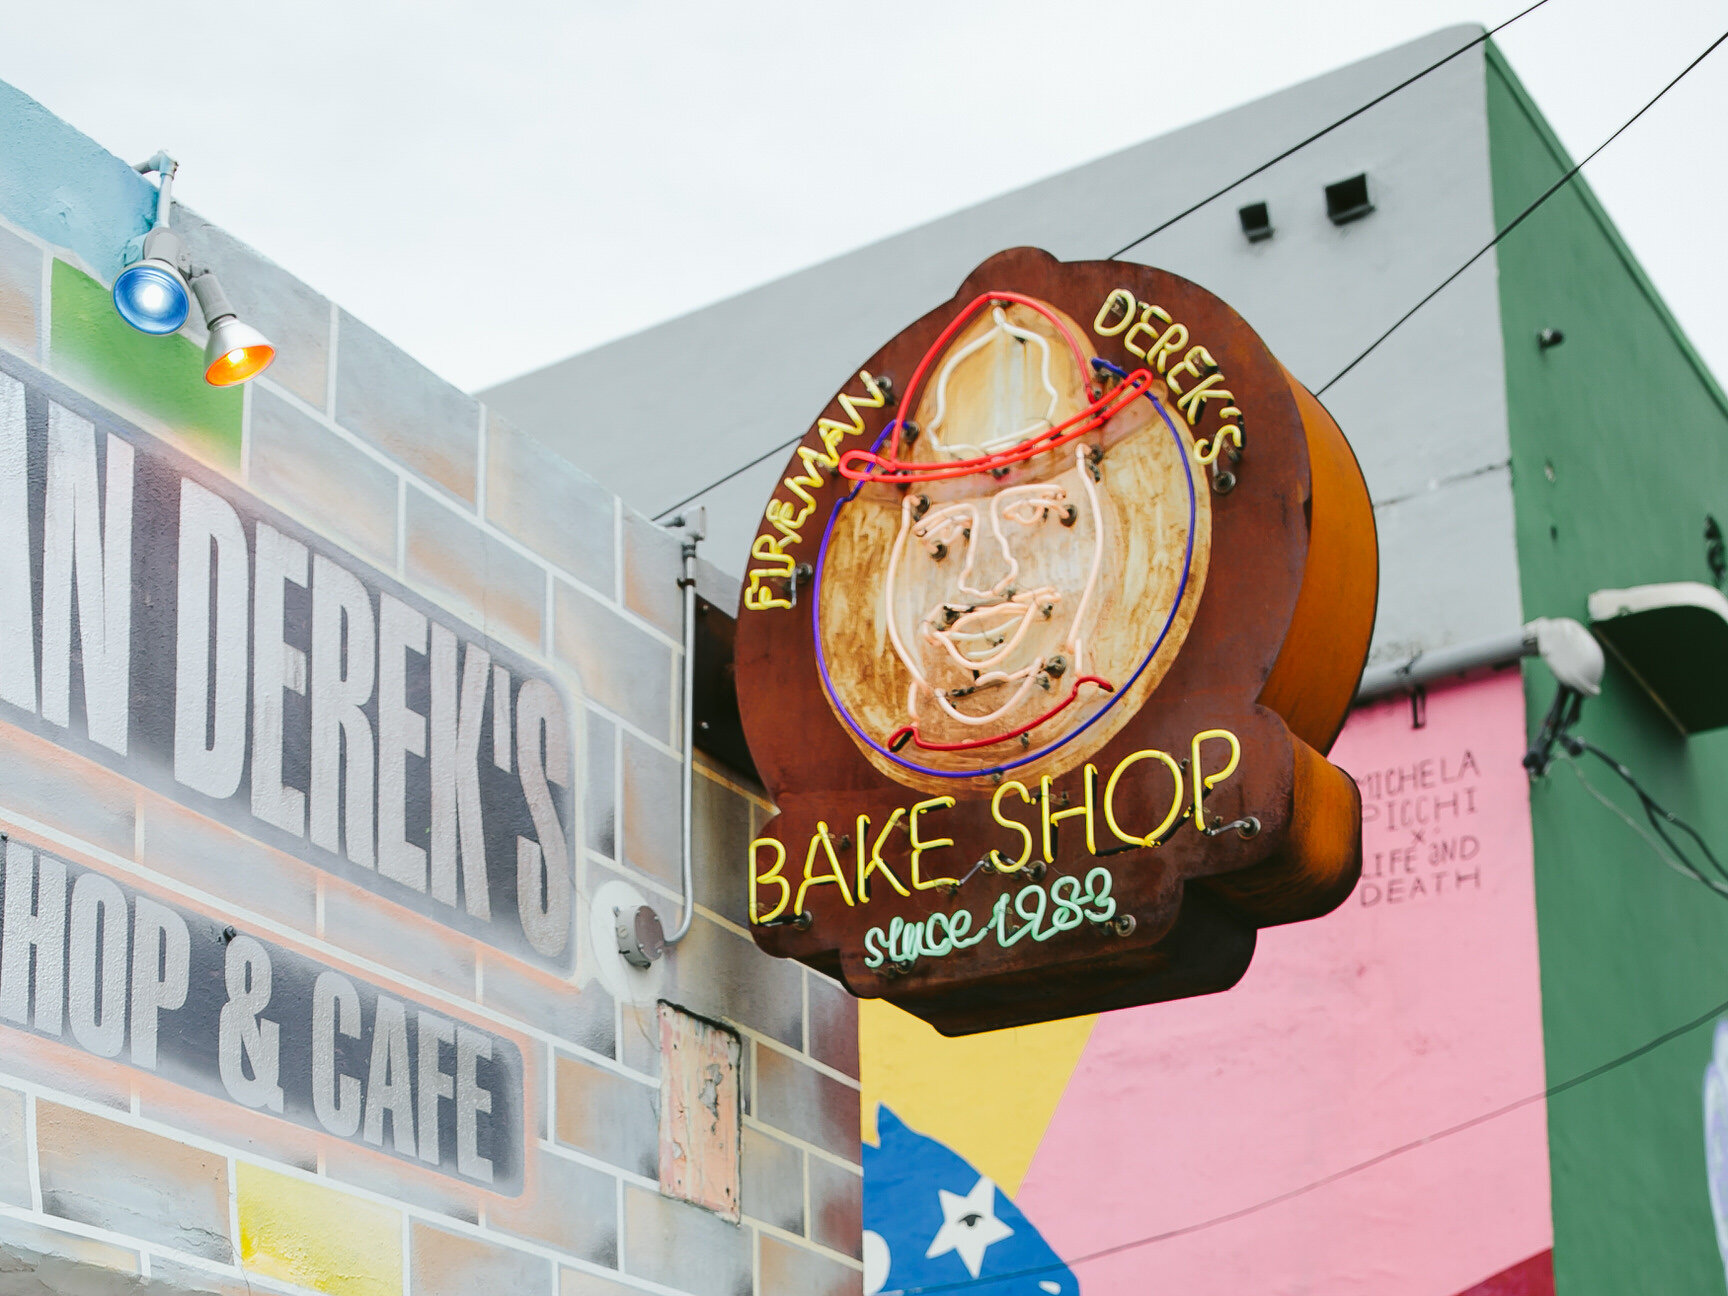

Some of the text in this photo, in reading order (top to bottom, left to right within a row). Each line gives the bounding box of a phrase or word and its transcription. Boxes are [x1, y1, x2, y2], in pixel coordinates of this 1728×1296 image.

[744, 288, 1242, 610] FIREMAN DEREK'S
[173, 476, 569, 958] DEREK'S
[749, 729, 1241, 925] BAKE SHOP
[864, 867, 1117, 967] since 1983
[1360, 865, 1481, 907] DEATH
[218, 935, 284, 1114] &
[312, 971, 493, 1184] CAFE
